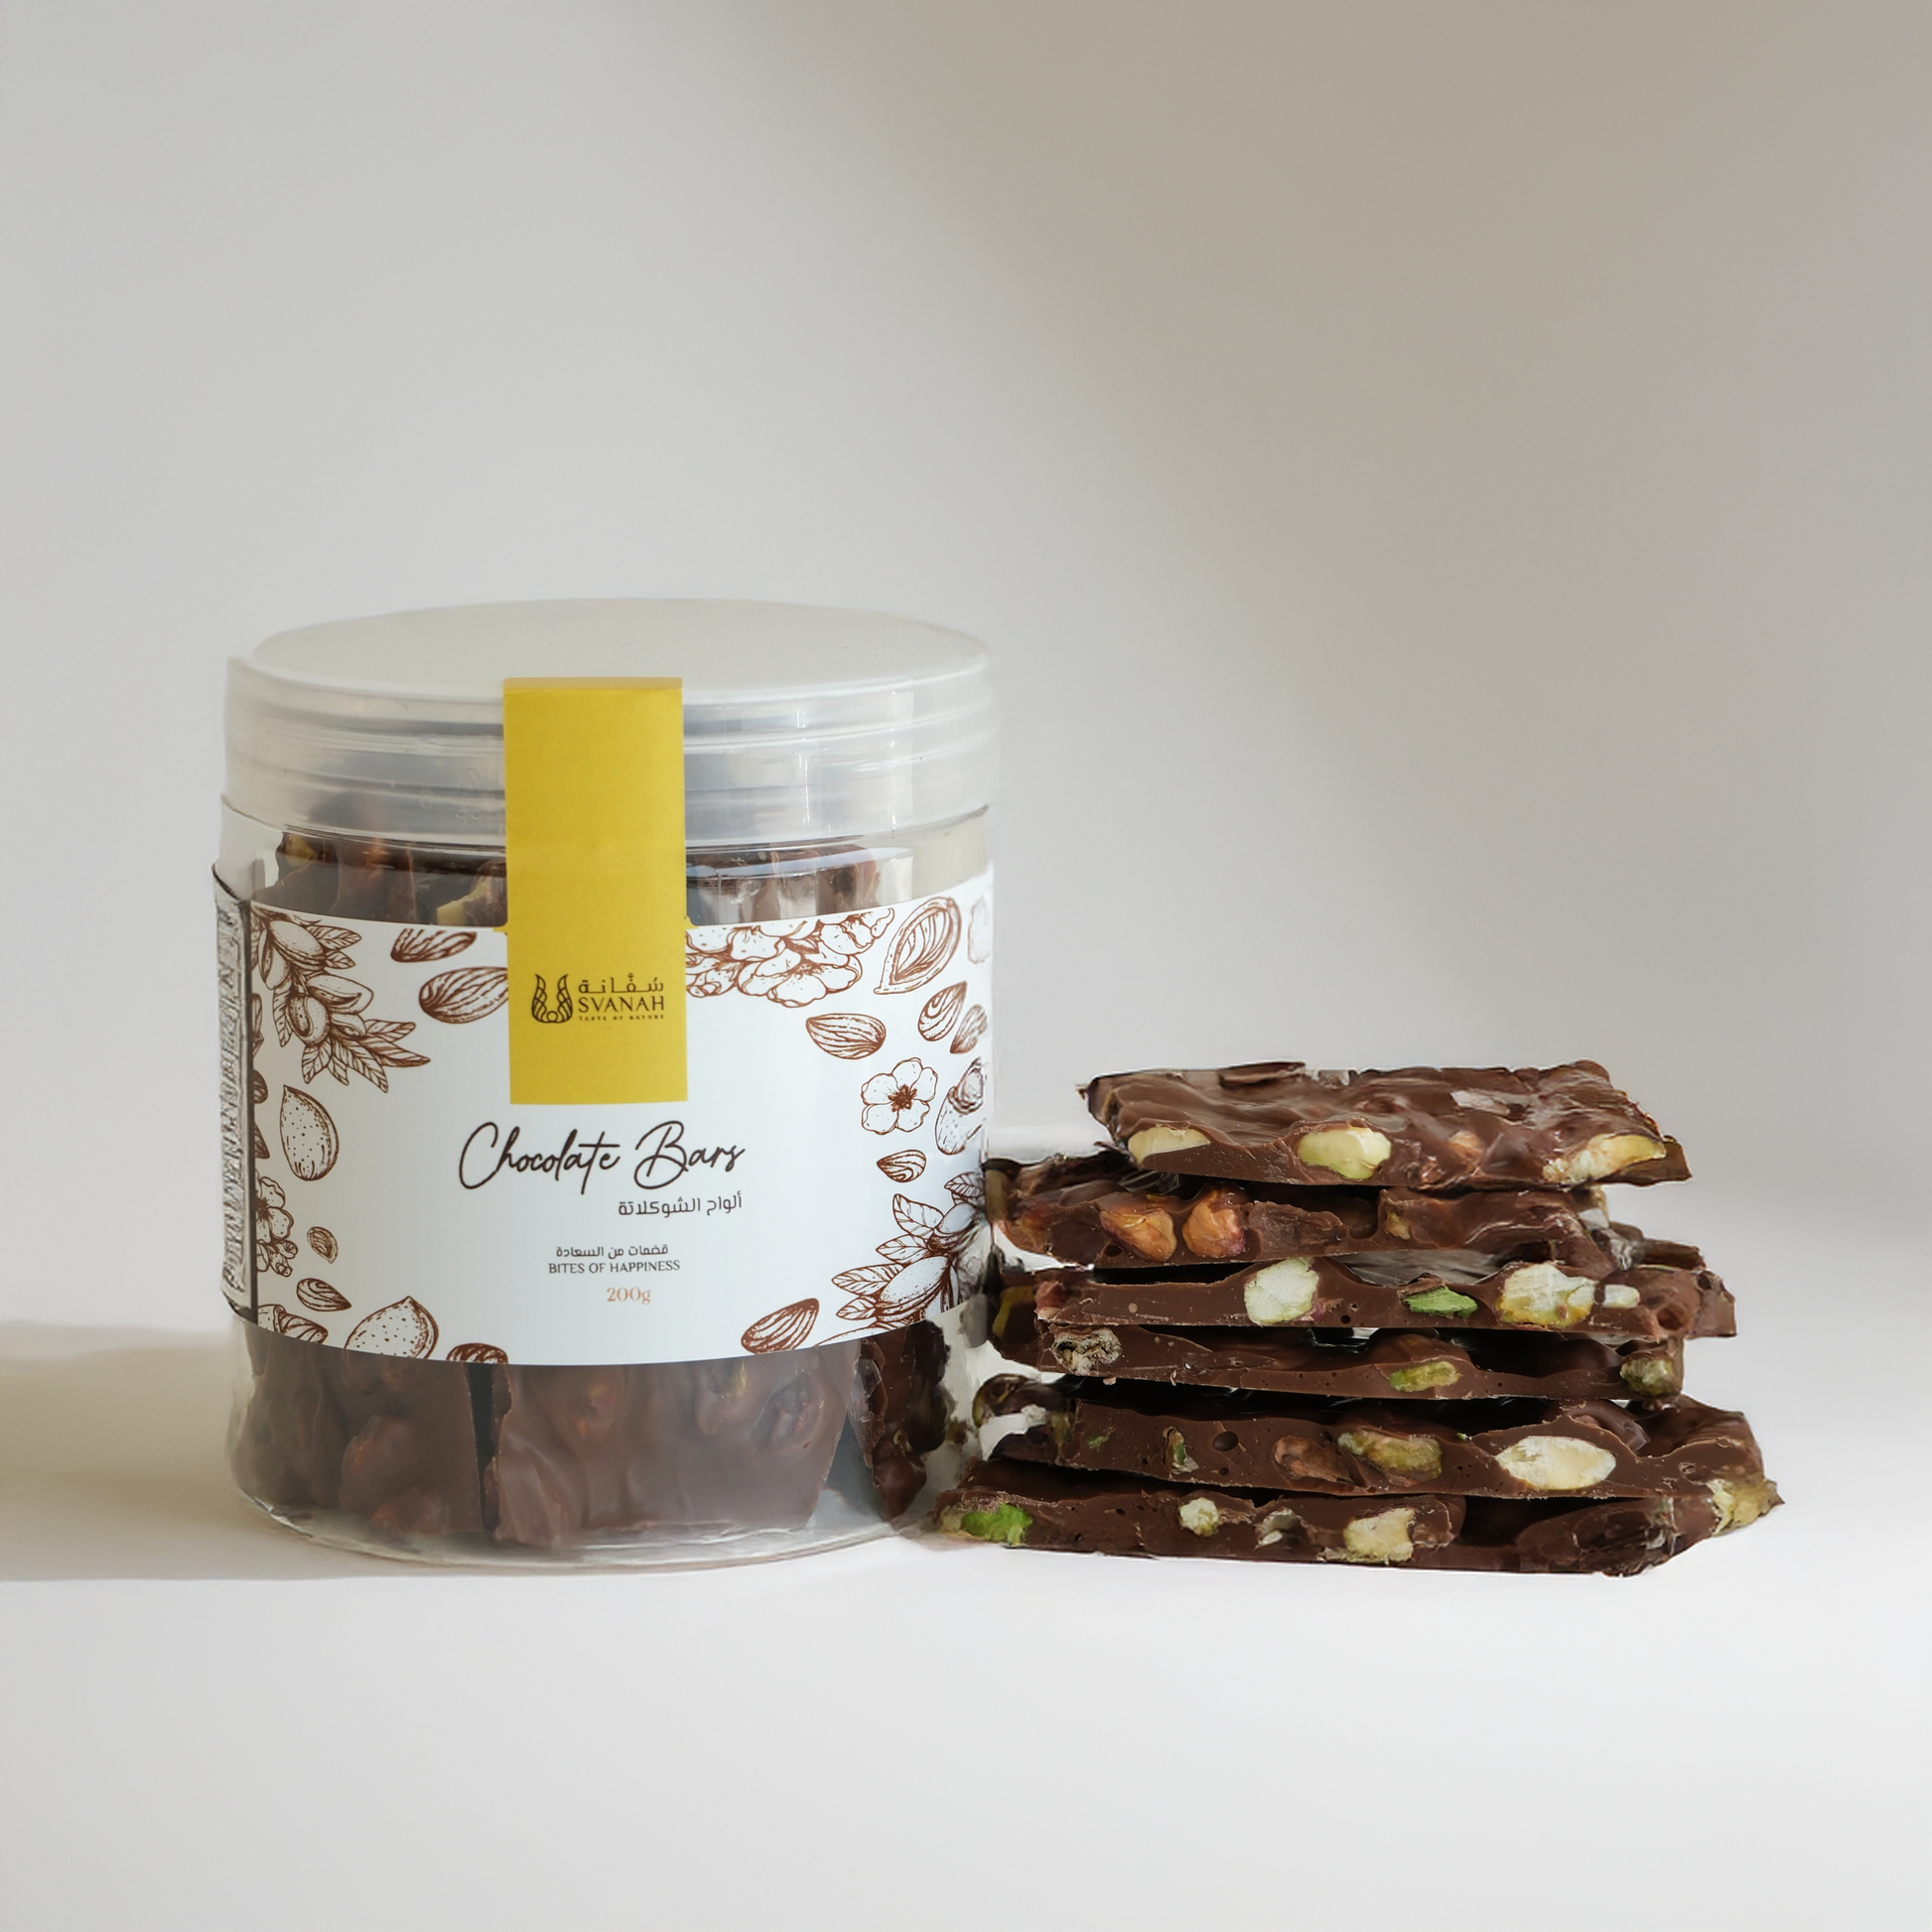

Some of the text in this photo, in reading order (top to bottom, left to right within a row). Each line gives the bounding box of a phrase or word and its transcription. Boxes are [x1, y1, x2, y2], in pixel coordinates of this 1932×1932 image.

[578, 996, 664, 1013] SVANAH
[459, 1120, 746, 1195] Chocolate Bars
[618, 1190, 743, 1218] ألواح الشوكلاتة
[555, 1244, 669, 1259] قضمات من السعادة
[548, 1259, 680, 1274] BITES OF HAPPINESS
[607, 1287, 651, 1306] 200g
